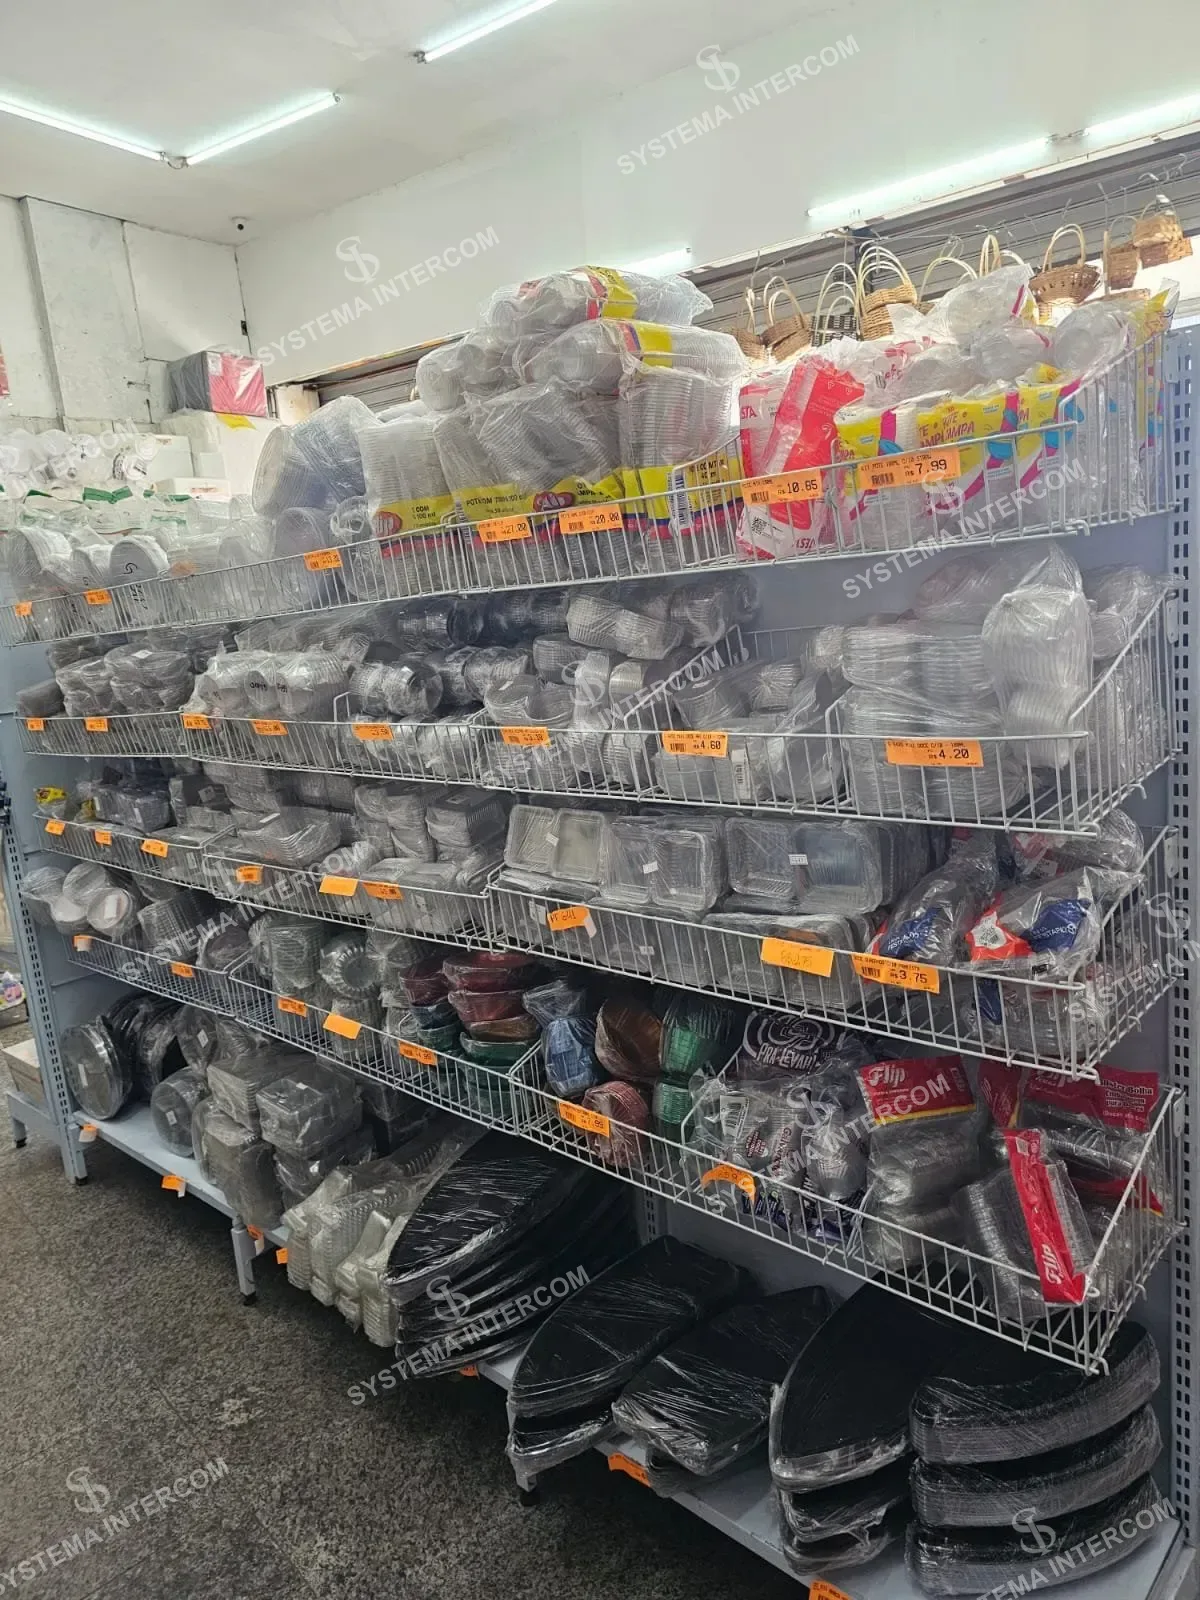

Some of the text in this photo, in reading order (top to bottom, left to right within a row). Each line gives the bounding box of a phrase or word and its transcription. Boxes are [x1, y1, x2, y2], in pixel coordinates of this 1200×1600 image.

[915, 459, 947, 475] 7.99
[700, 740, 721, 749] 4.60
[939, 748, 969, 759] 4.20
[899, 969, 928, 984] 3.75
[868, 1063, 906, 1087] Flip
